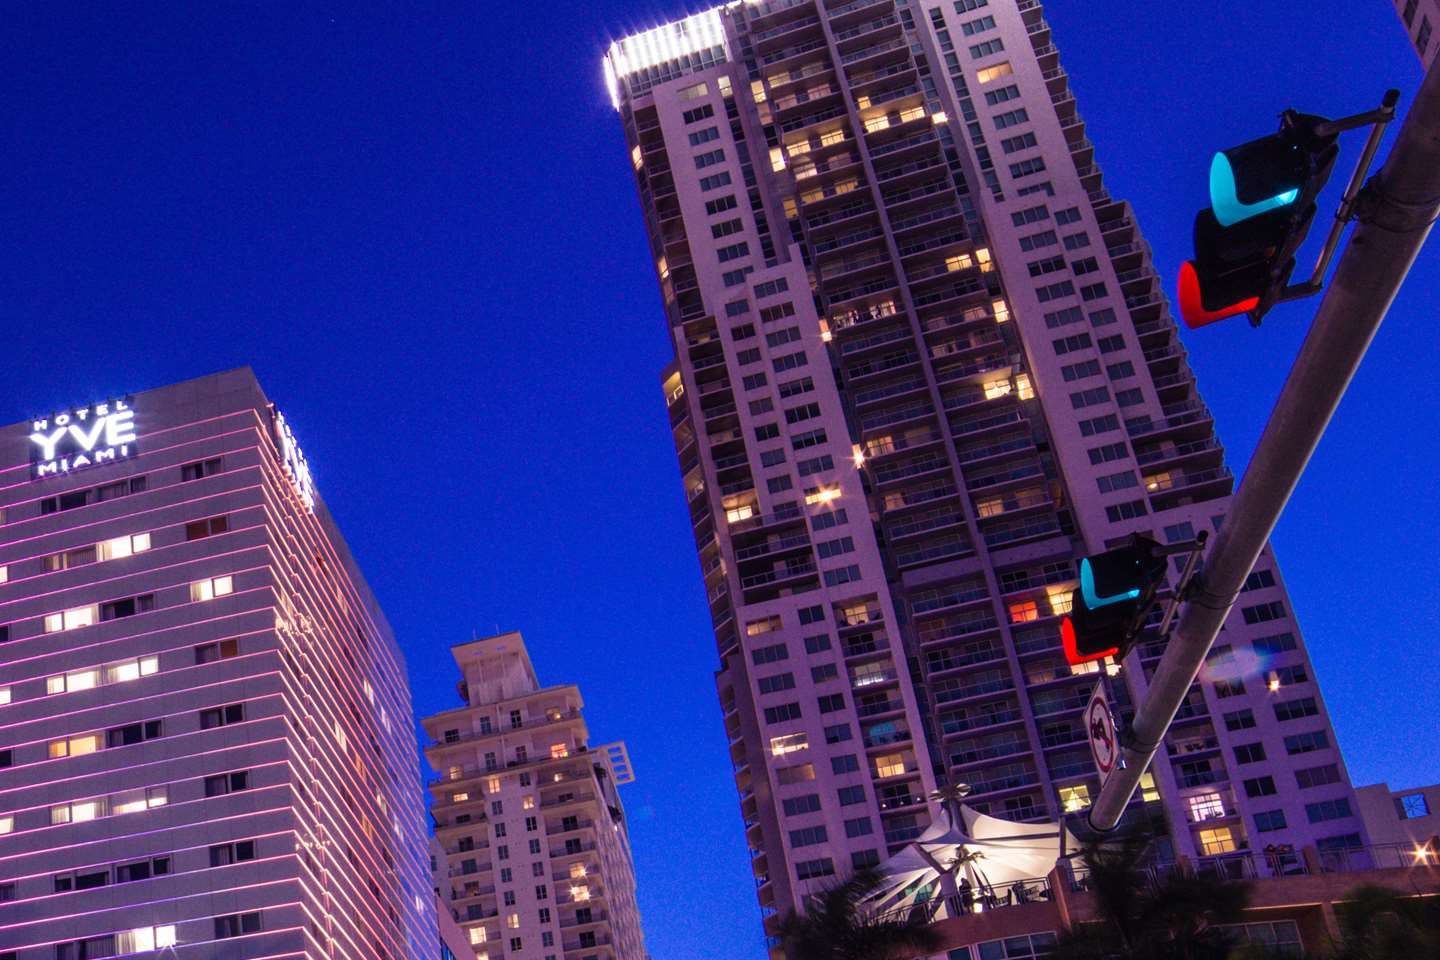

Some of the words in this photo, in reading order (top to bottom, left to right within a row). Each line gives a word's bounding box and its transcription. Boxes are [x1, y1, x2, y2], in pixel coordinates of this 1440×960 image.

[34, 401, 128, 431] HOTEL
[30, 411, 136, 460] YVE
[38, 445, 128, 475] MIAMI
